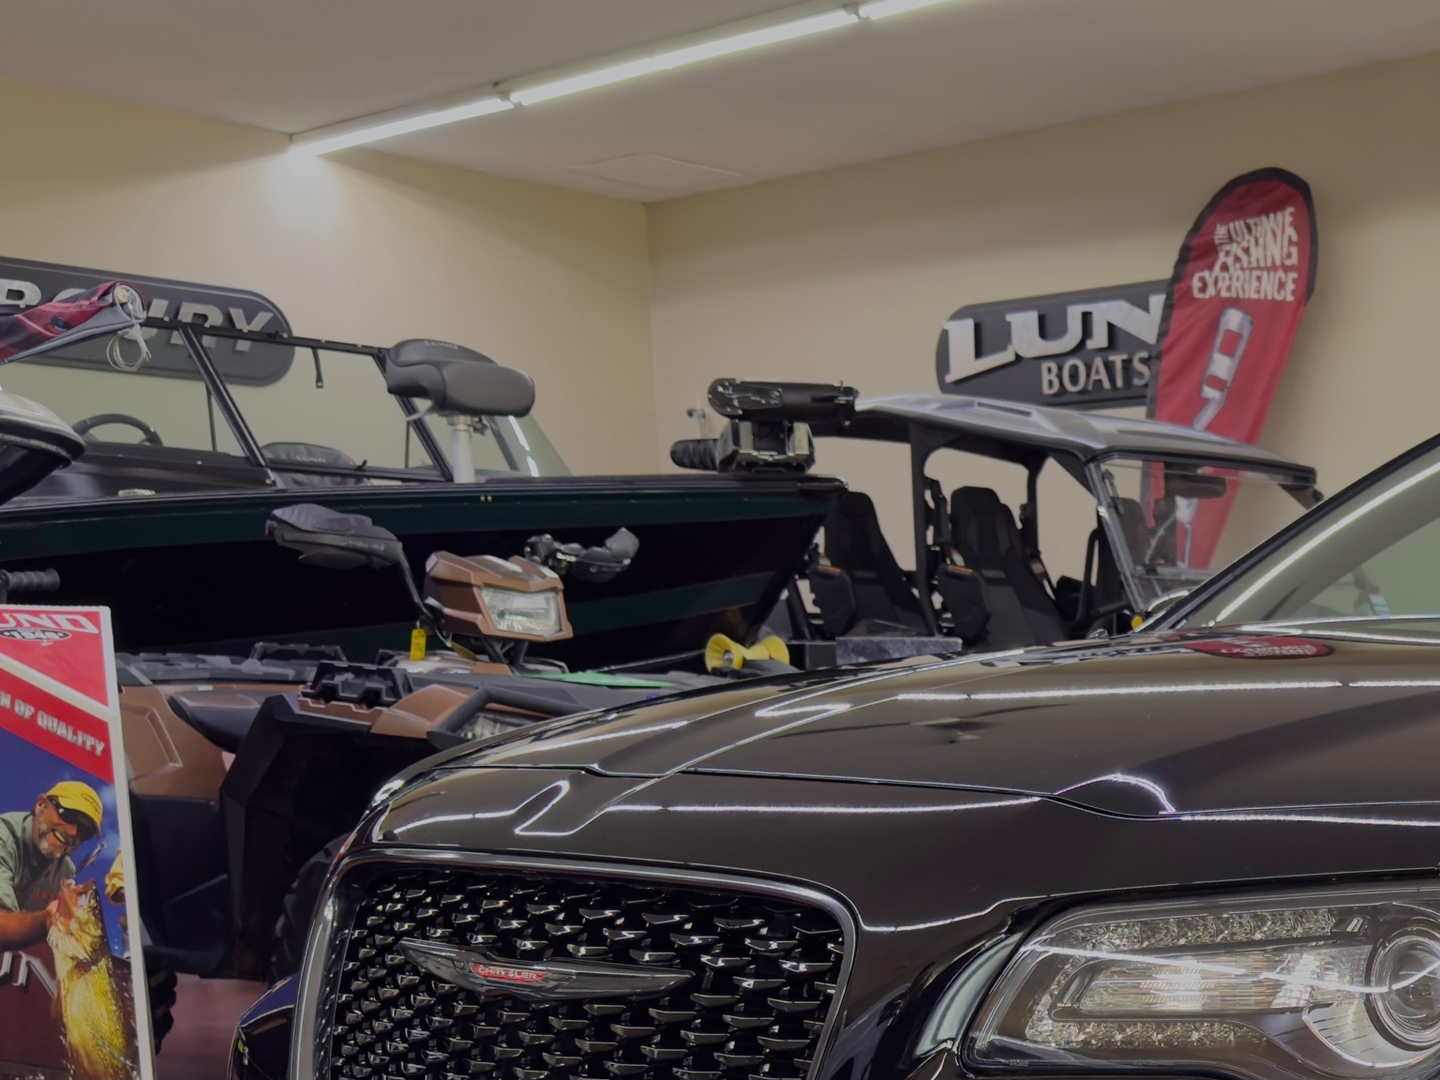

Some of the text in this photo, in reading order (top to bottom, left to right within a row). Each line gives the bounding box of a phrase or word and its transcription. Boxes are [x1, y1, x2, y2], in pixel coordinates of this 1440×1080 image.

[1191, 270, 1298, 302] EXPERIENCE
[944, 294, 1166, 383] LUN
[1041, 351, 1151, 395] BOATS
[14, 698, 35, 720] OF
[37, 710, 105, 757] QUALITY
[479, 965, 538, 980] CHRYSLER
